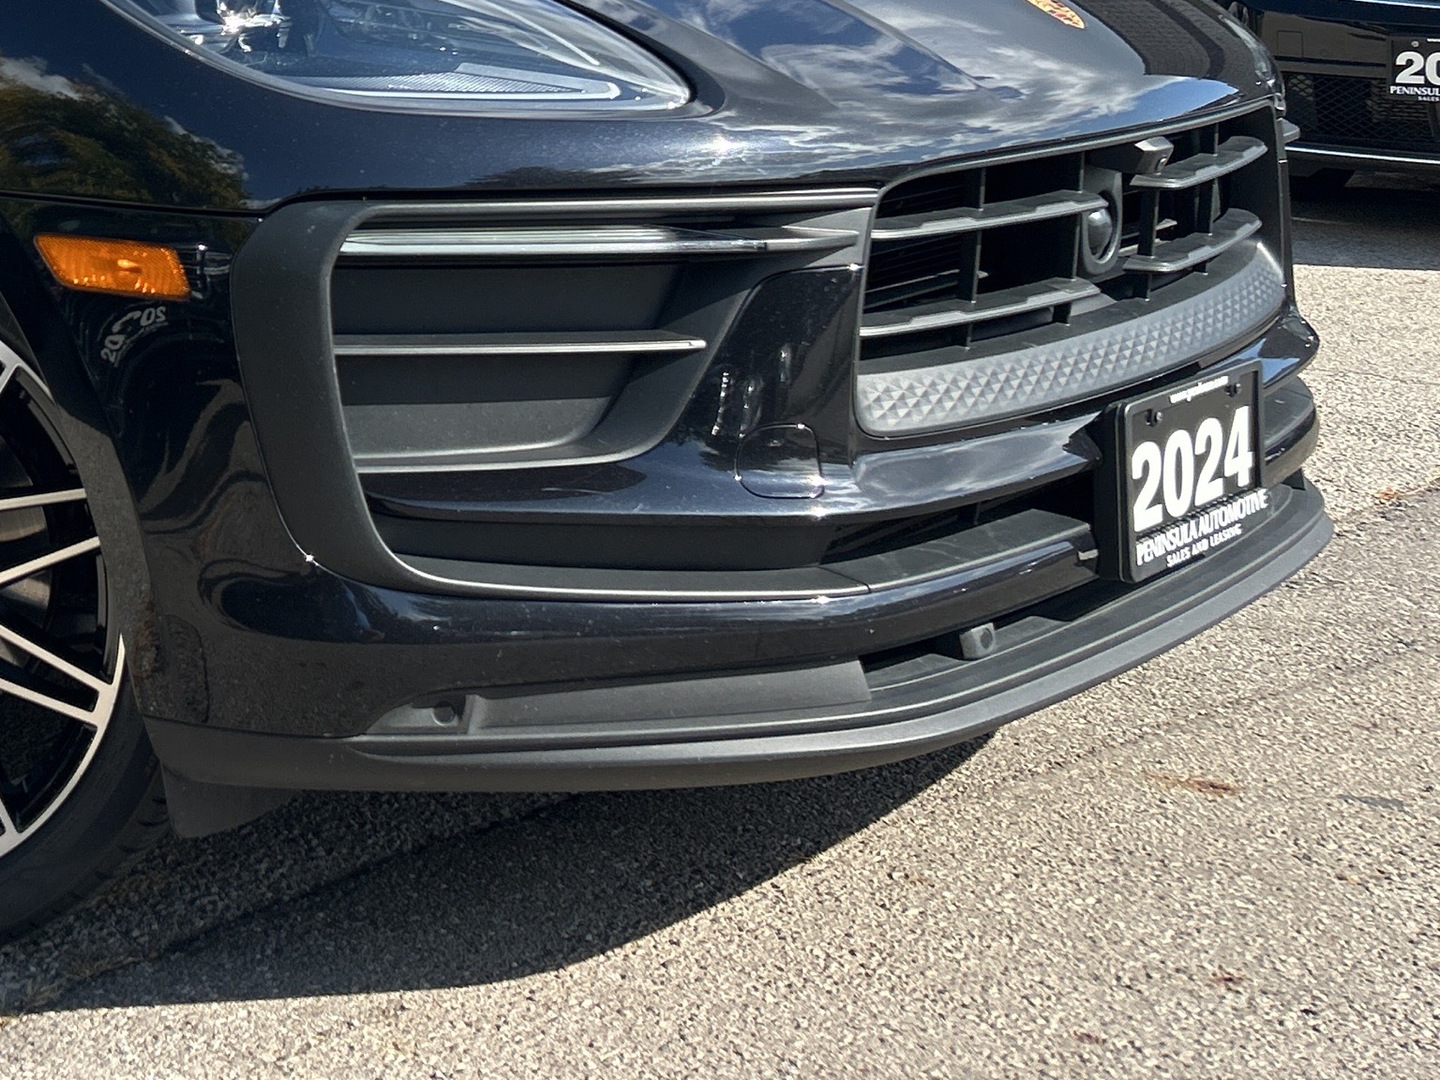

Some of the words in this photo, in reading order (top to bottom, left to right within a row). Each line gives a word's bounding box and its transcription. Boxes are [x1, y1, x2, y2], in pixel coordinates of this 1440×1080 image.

[1131, 405, 1254, 533] 2024
[1136, 518, 1199, 567] PENINSULA
[1198, 488, 1269, 536] AUTOMOTIVE
[1166, 546, 1192, 568] SALES
[1192, 538, 1209, 556] AND
[1209, 523, 1243, 547] LEASING
